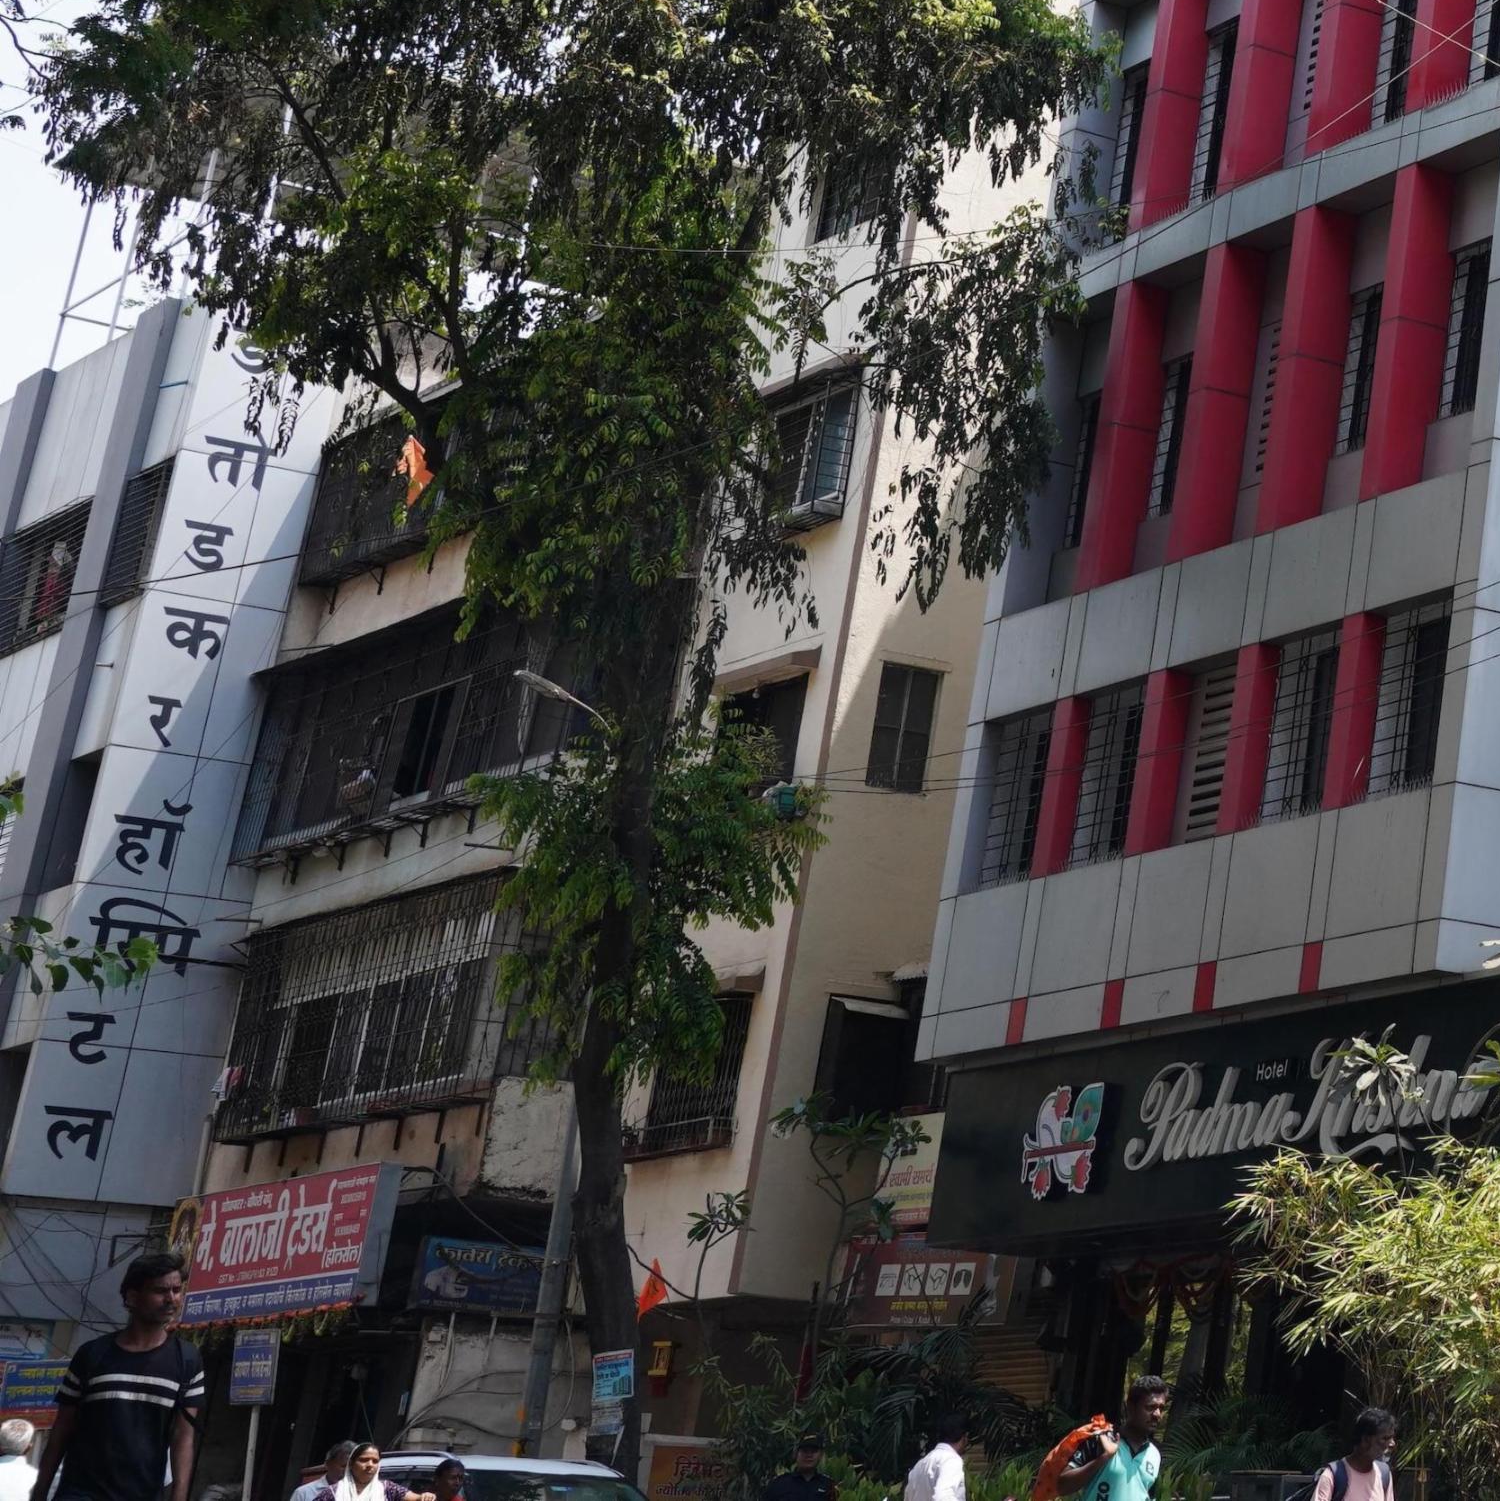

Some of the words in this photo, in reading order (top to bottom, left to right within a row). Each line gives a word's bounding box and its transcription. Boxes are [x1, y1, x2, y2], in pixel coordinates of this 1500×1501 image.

[1123, 1062, 1299, 1172] Padma
[1256, 1059, 1289, 1082] Hotel
[195, 1200, 217, 1272] मे.
[219, 1188, 290, 1268] बालाजी
[286, 1178, 338, 1271] ट्रेडर्स
